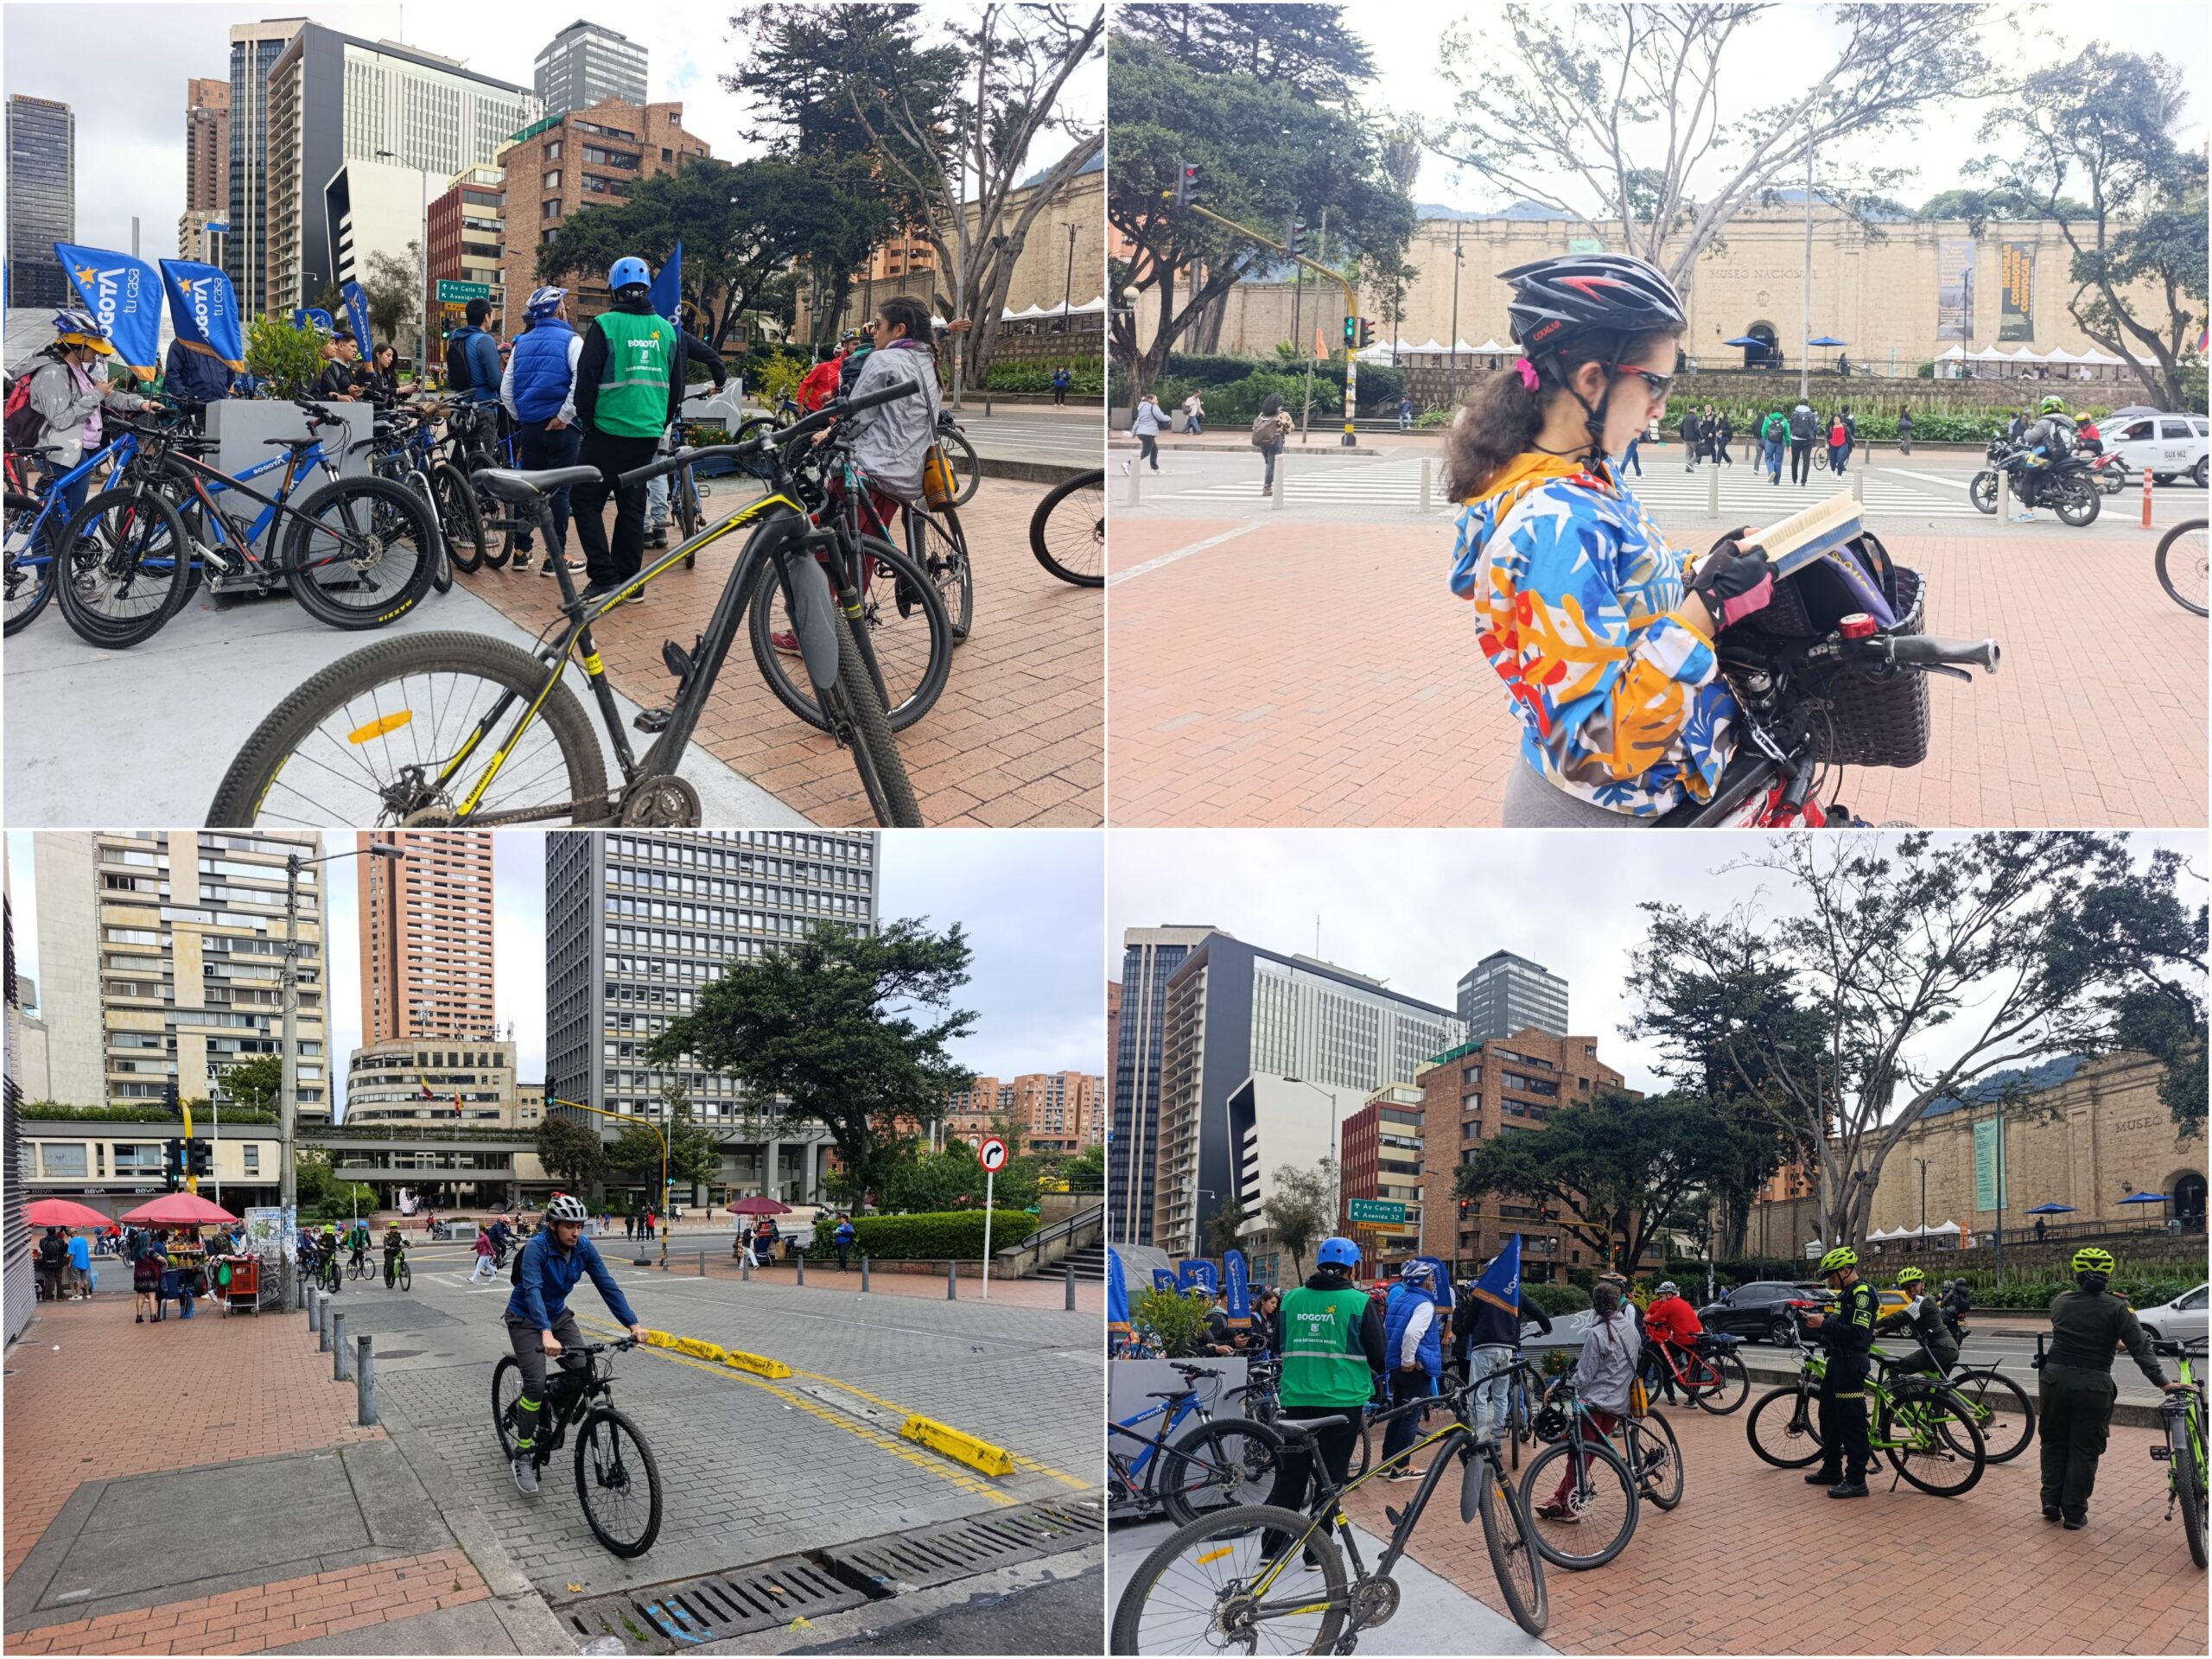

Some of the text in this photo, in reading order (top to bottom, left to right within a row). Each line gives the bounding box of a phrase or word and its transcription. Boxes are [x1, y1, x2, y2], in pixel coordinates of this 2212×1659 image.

[1710, 269, 1819, 279] MUSEO NACIONL
[123, 268, 140, 314] tu casa
[213, 277, 224, 316] tu casa
[1533, 320, 1562, 341] COUGAR
[378, 598, 413, 622] MAXXIS
[2115, 1115, 2163, 1134] MUSEO
